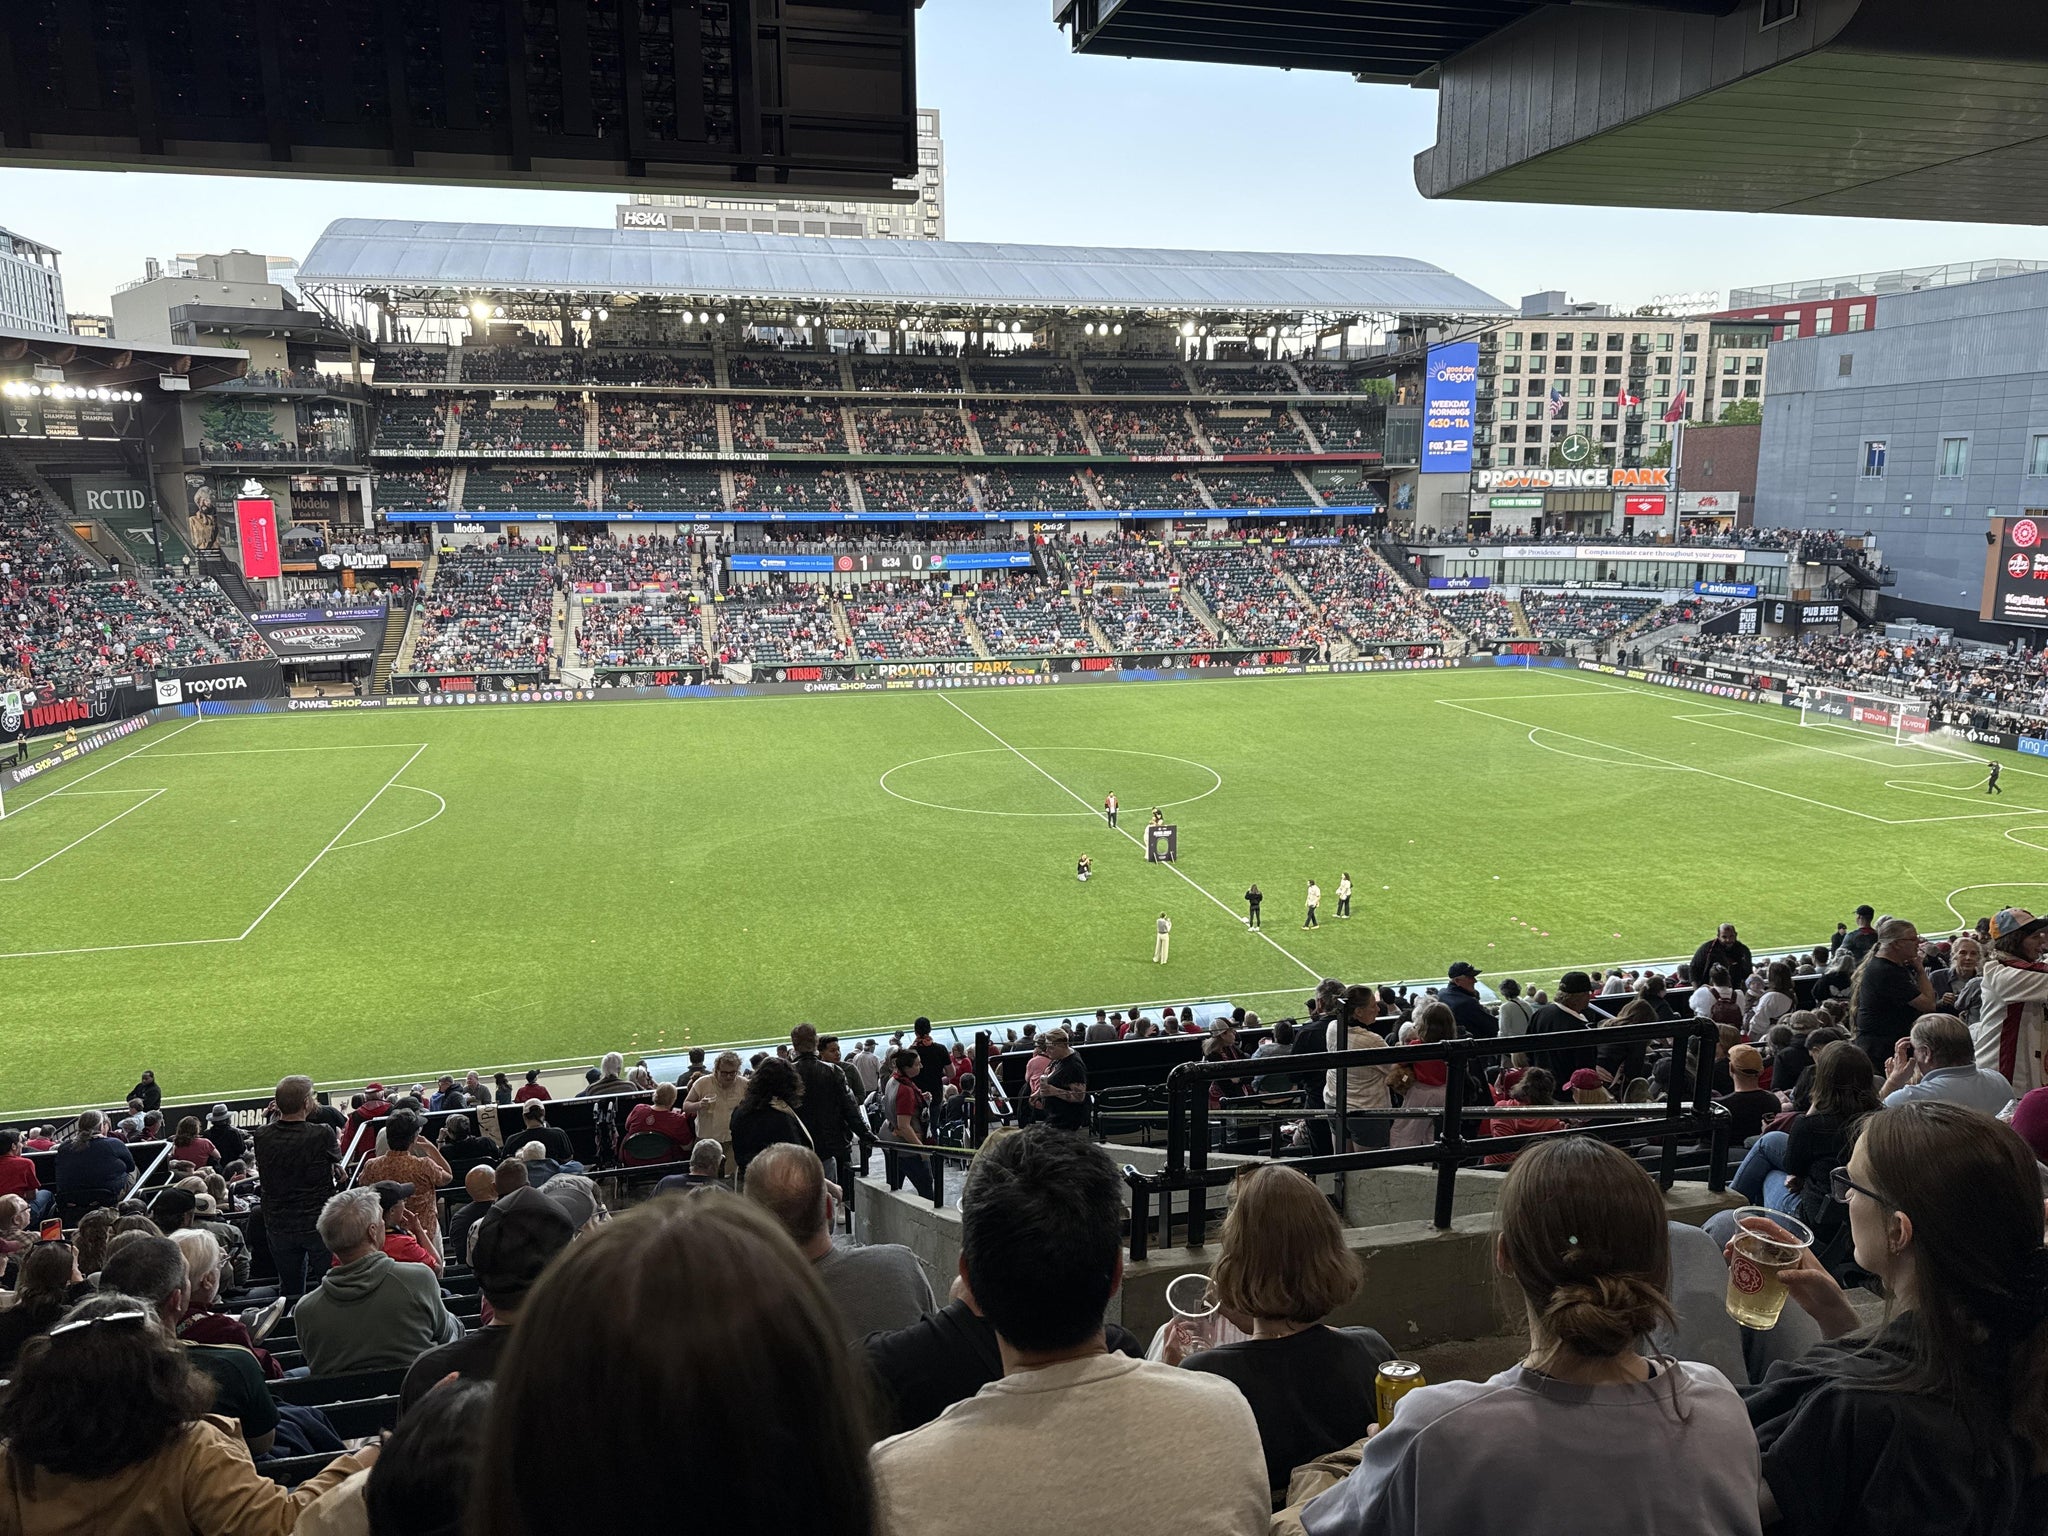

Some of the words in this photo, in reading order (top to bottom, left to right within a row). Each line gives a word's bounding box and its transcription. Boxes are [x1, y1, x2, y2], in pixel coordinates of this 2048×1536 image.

[624, 212, 666, 226] HOKA
[1437, 370, 1474, 383] Oregon
[1429, 441, 1444, 450] FOX
[1444, 440, 1468, 451] 12
[1478, 468, 1608, 488] PROVIDENCE
[1612, 468, 1672, 488] PARK
[86, 490, 145, 510] RCTID
[292, 497, 330, 509] Modelo
[454, 523, 484, 534] Modelo
[1584, 549, 1637, 557] Compassionate
[860, 555, 868, 571] 1
[882, 558, 900, 567] 8:34
[912, 555, 922, 570] 0
[291, 577, 328, 590] TRAPPER
[1447, 579, 1471, 588] xfinity
[1708, 583, 1736, 594] axiom
[2005, 593, 2046, 606] KeyBank
[1740, 612, 1756, 622] PUB
[1803, 606, 1819, 616] PUB
[1820, 606, 1838, 616] BEER
[786, 667, 822, 682] THORNS
[821, 667, 832, 681] FC
[879, 662, 973, 676] PROVIDNCE
[974, 661, 1013, 673] PARK
[1242, 667, 1302, 675] NWSLSHOP.com
[185, 676, 248, 694] TOYOTA
[439, 677, 476, 692] THORN
[480, 676, 492, 690] FC
[814, 682, 882, 691] NWSLSHOP.com
[300, 699, 380, 709] NWSLSHOP.com
[1863, 712, 1887, 722] TOYOTA
[1978, 732, 2000, 744] Tech
[2021, 740, 2039, 753] ring
[19, 756, 61, 780] NWSLSHOP.com
